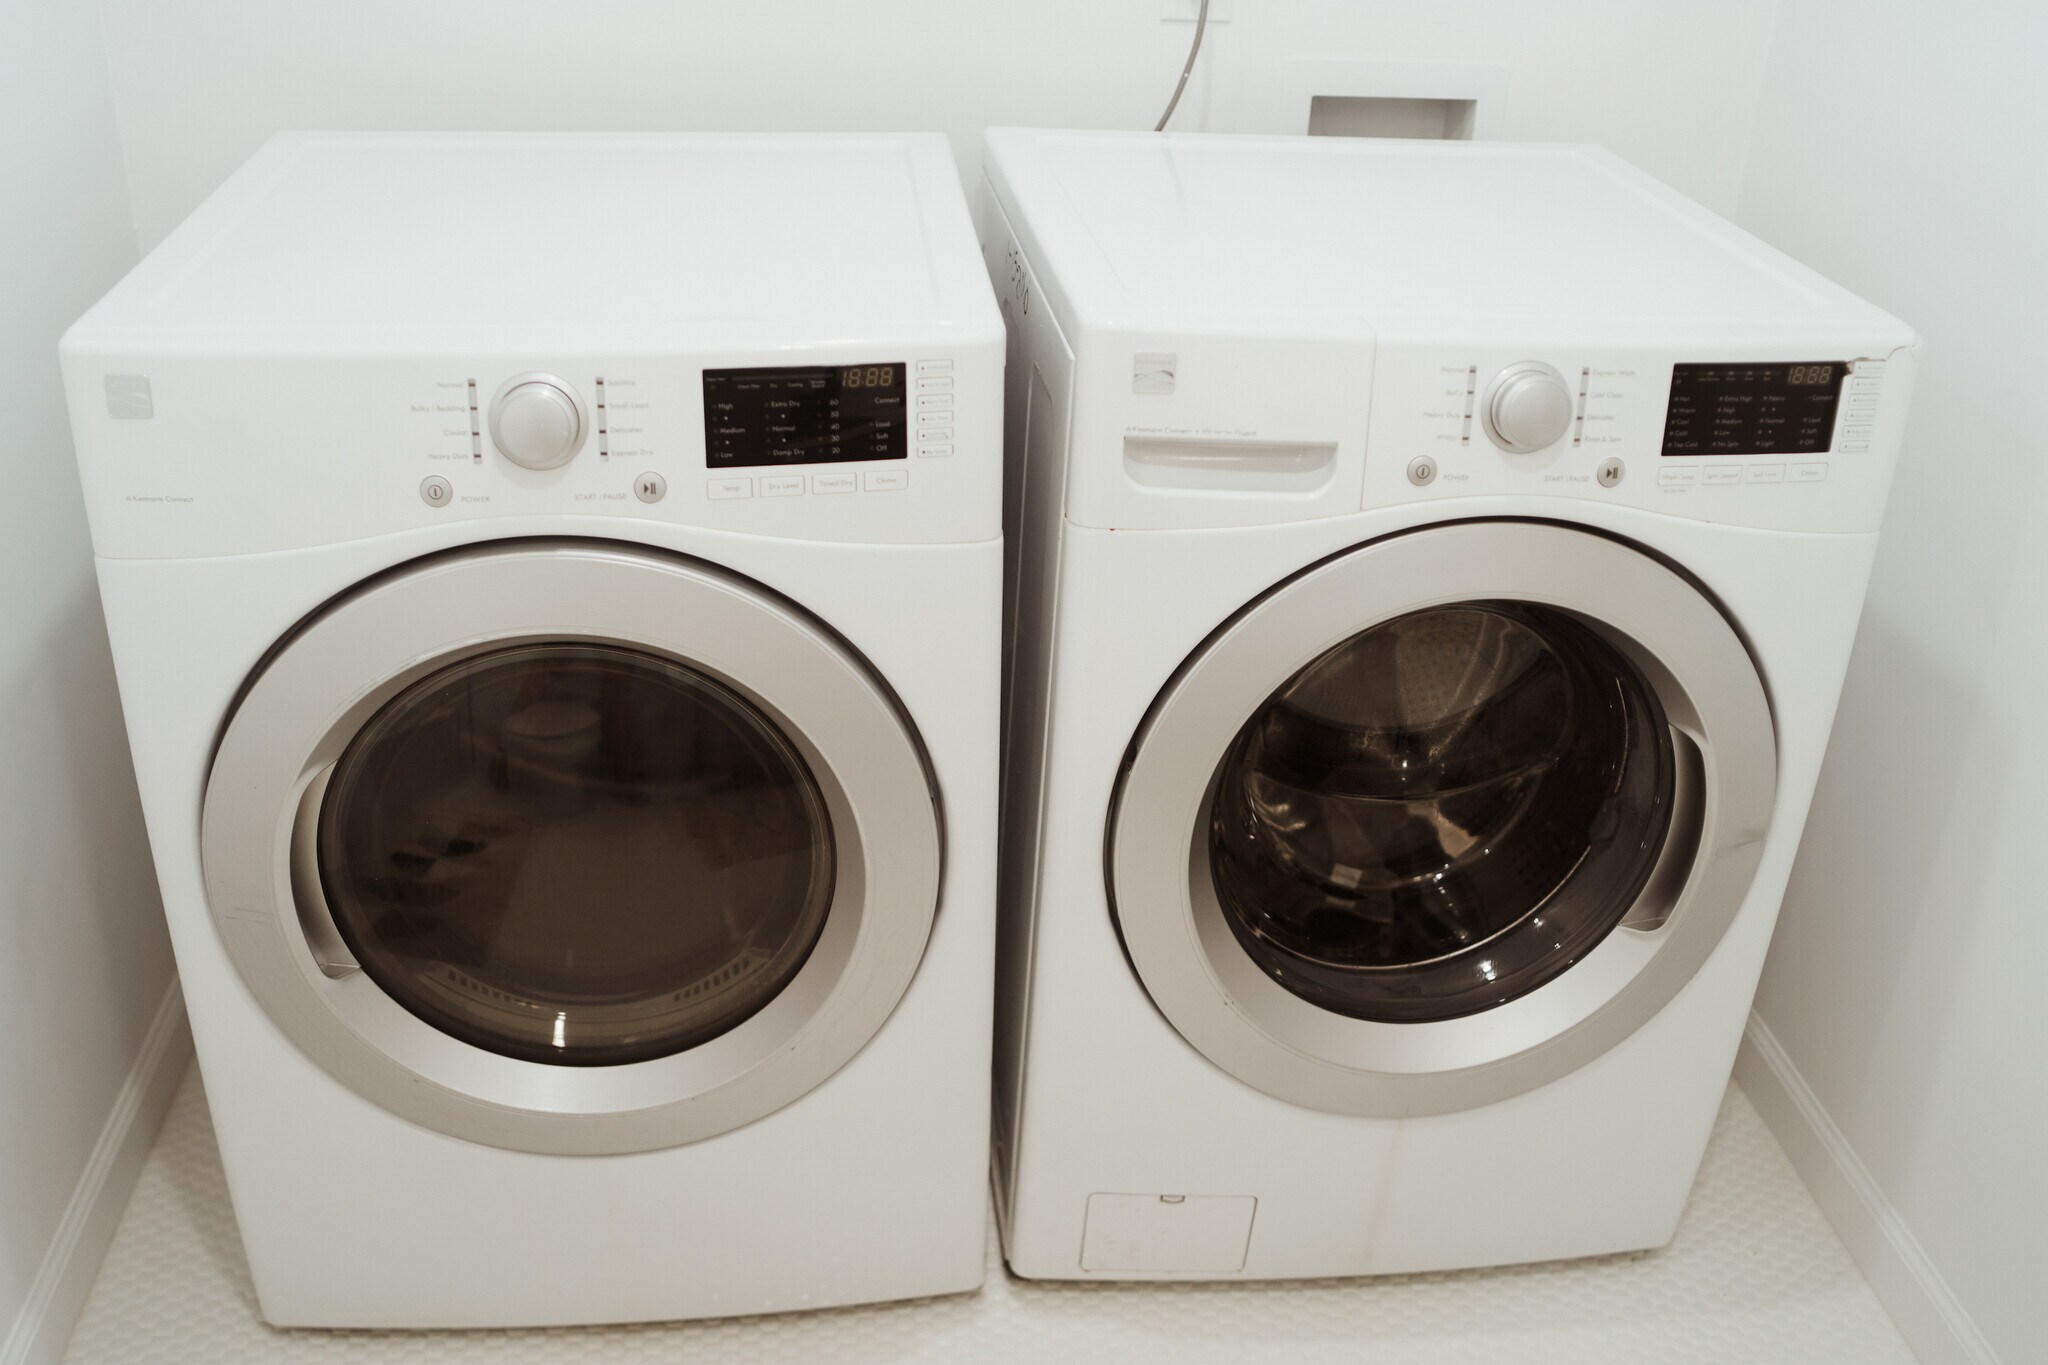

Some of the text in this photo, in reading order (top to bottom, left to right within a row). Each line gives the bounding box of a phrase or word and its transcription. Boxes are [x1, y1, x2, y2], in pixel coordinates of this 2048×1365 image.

[829, 397, 840, 407] 60
[874, 396, 901, 405] Connect
[1679, 395, 1691, 403] Hot
[1739, 394, 1753, 403] High
[1767, 395, 1786, 403] Heavy
[630, 401, 649, 409] Load
[718, 402, 734, 411] High
[771, 399, 801, 408] Extra Dry
[829, 409, 840, 419] 50
[1722, 405, 1737, 414] High
[875, 419, 892, 429] Loud
[1675, 417, 1691, 425] Cool
[1720, 417, 1744, 425] Medium
[1764, 416, 1786, 424] Normal
[771, 424, 797, 433] Normal
[830, 421, 841, 431] 40
[875, 432, 889, 441] Soft
[1674, 429, 1689, 437] Cold
[1718, 429, 1732, 437] Low
[830, 433, 841, 443] 30
[1684, 439, 1699, 447] Cold
[1726, 439, 1741, 449] Spin
[1760, 439, 1776, 448] Light
[1803, 439, 1816, 447] Off
[640, 448, 653, 457] Dry
[772, 447, 806, 457] Damp Dry
[831, 445, 842, 455] 20
[875, 443, 889, 453] Off
[427, 452, 469, 461] Heavy Duty
[720, 451, 734, 459] Low
[1443, 473, 1470, 481] POWER
[1543, 474, 1591, 483] START PAUSE
[768, 481, 800, 491] Dry Level
[818, 478, 853, 488] Timed Dry
[722, 484, 741, 493] Temp
[133, 495, 194, 503] Kenmore Connect
[461, 495, 491, 503] POWER
[574, 493, 627, 502] START PAUSE
